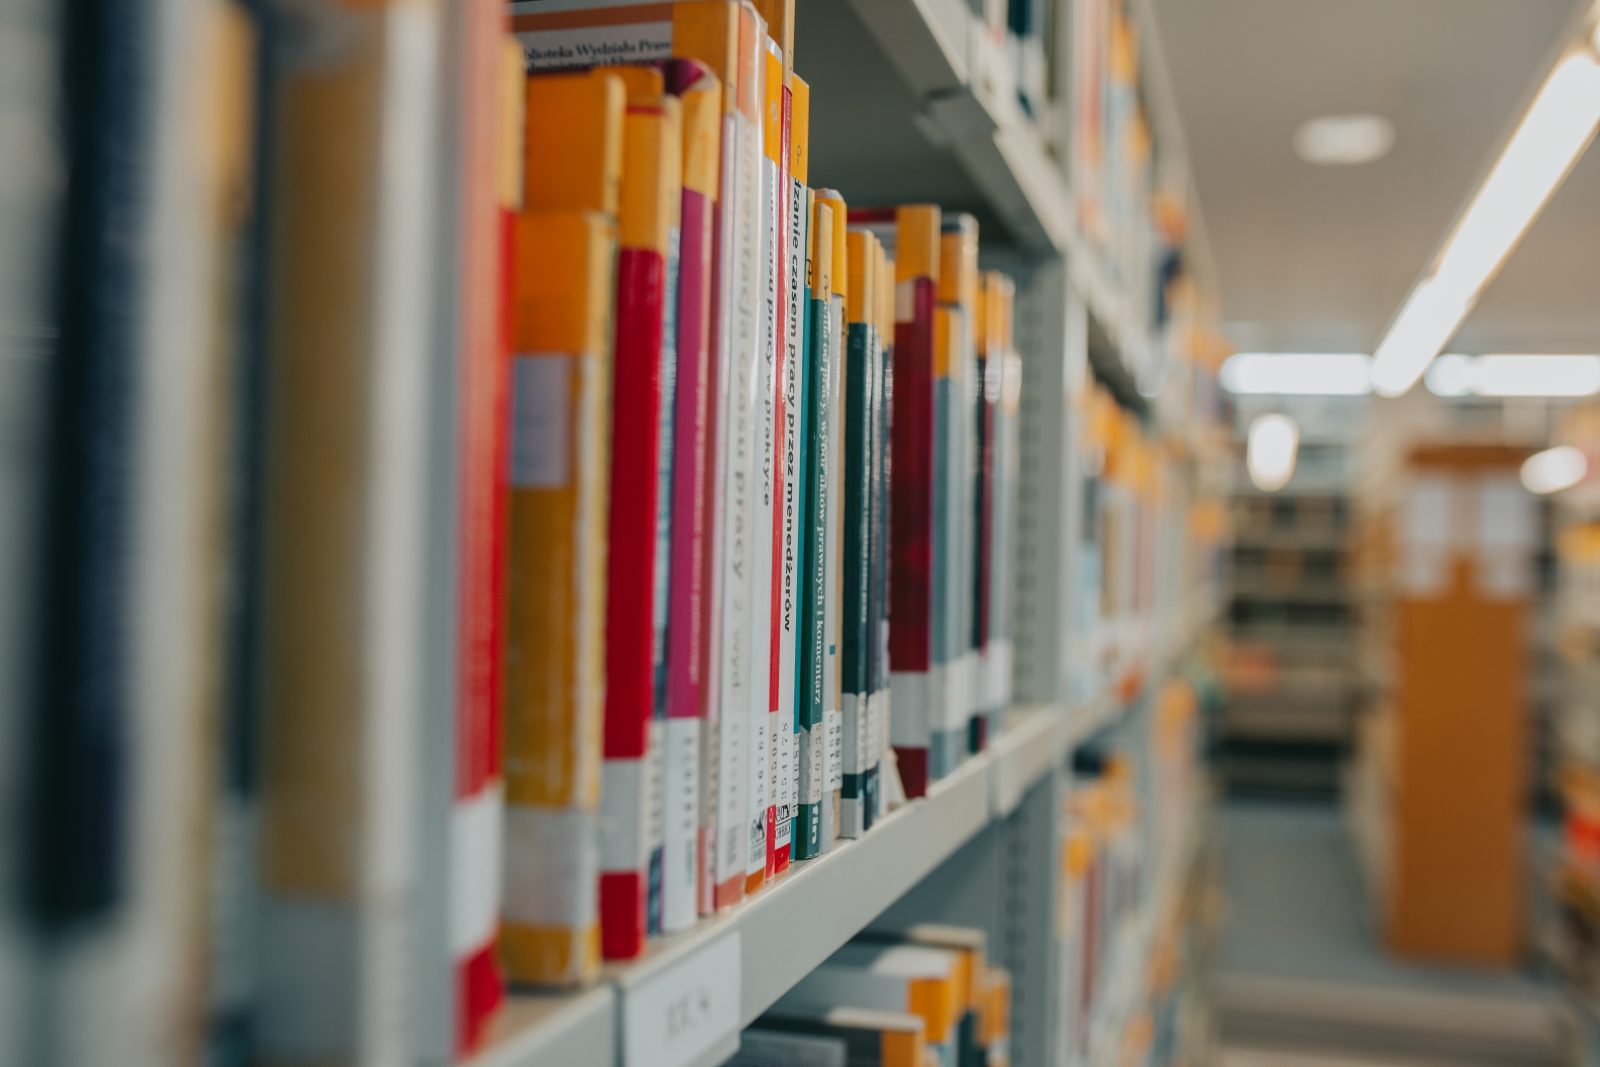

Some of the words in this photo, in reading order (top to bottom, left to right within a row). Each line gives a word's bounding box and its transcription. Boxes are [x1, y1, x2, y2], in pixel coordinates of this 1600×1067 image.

[765, 298, 773, 365] pracy
[789, 254, 798, 338] czasem
[787, 343, 796, 408] pracy
[762, 399, 771, 506] praktyce
[786, 413, 795, 476] przez
[784, 482, 792, 632] menedżerów
[816, 526, 825, 606] prawnych
[815, 619, 824, 705] komentarz
